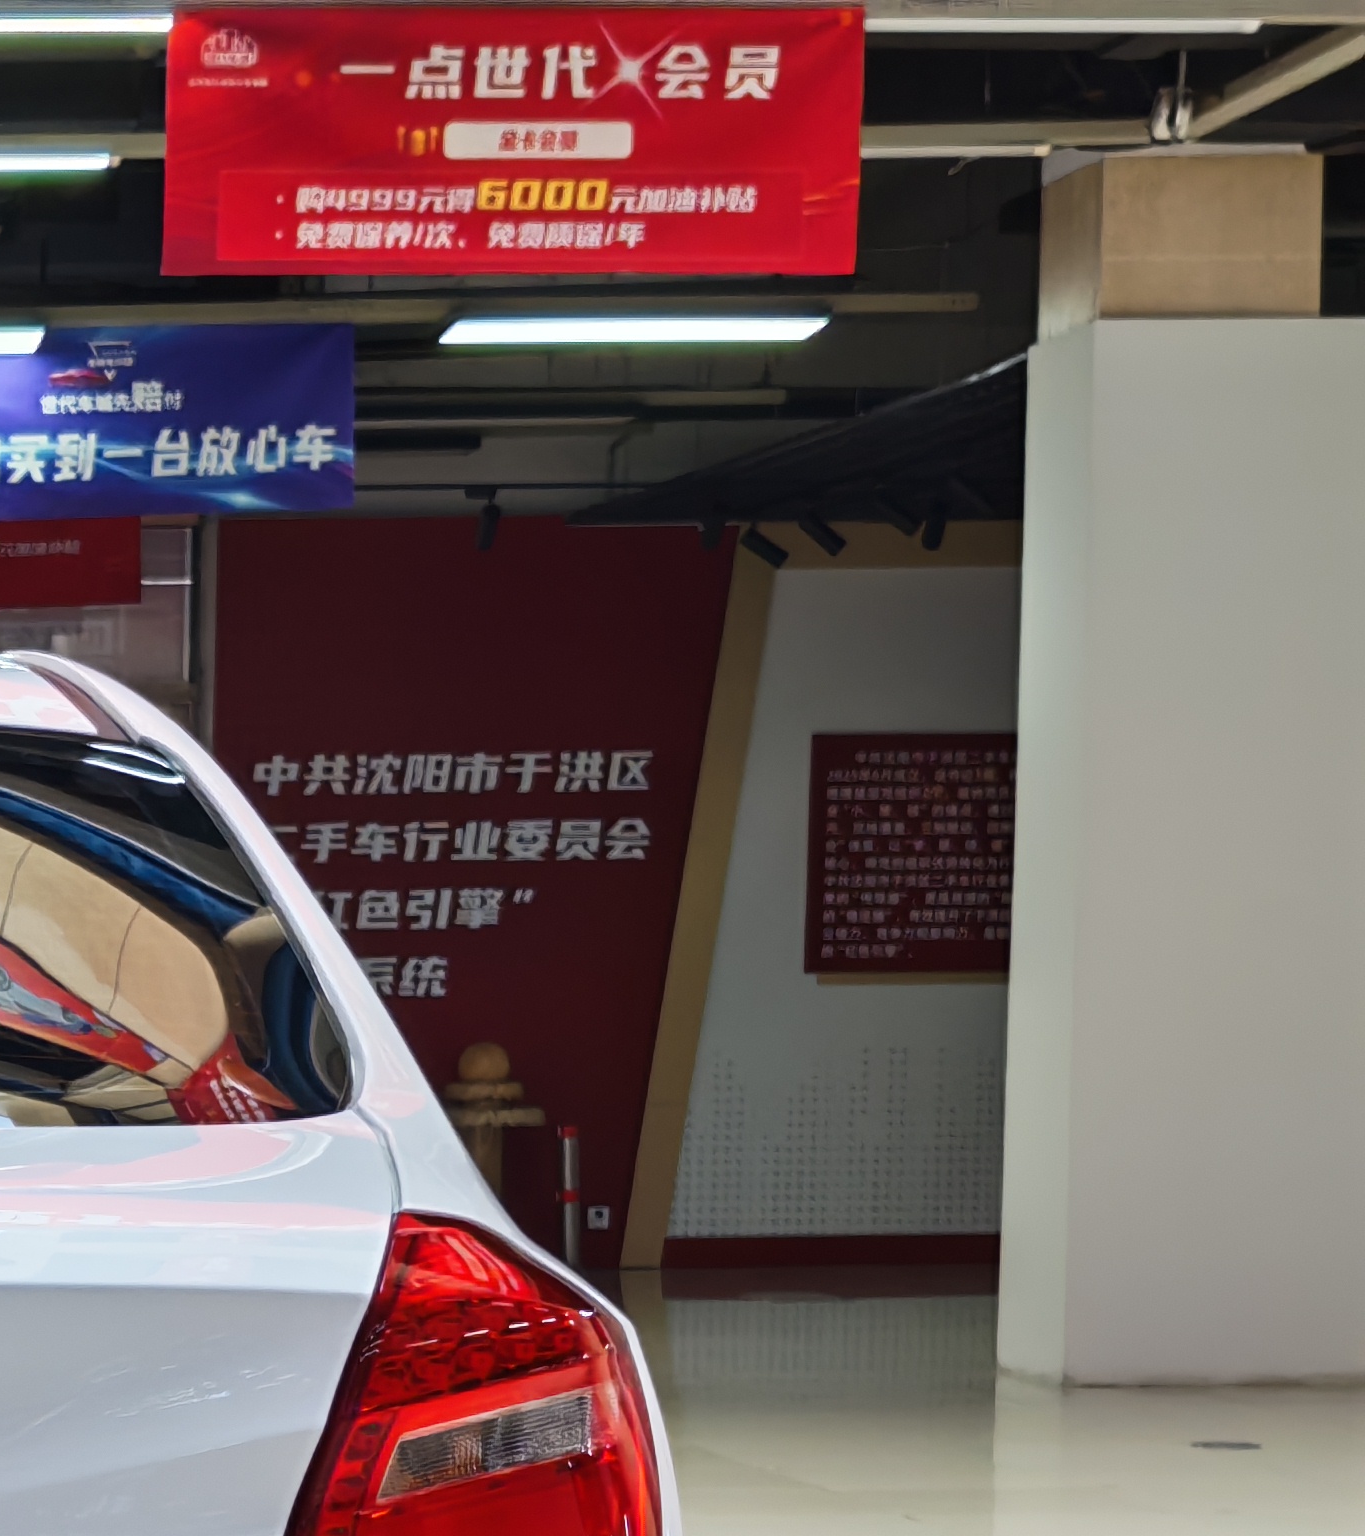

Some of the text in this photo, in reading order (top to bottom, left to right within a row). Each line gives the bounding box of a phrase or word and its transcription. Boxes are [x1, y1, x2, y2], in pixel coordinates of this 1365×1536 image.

[253, 750, 655, 796] 中共沈阳市于洪区
